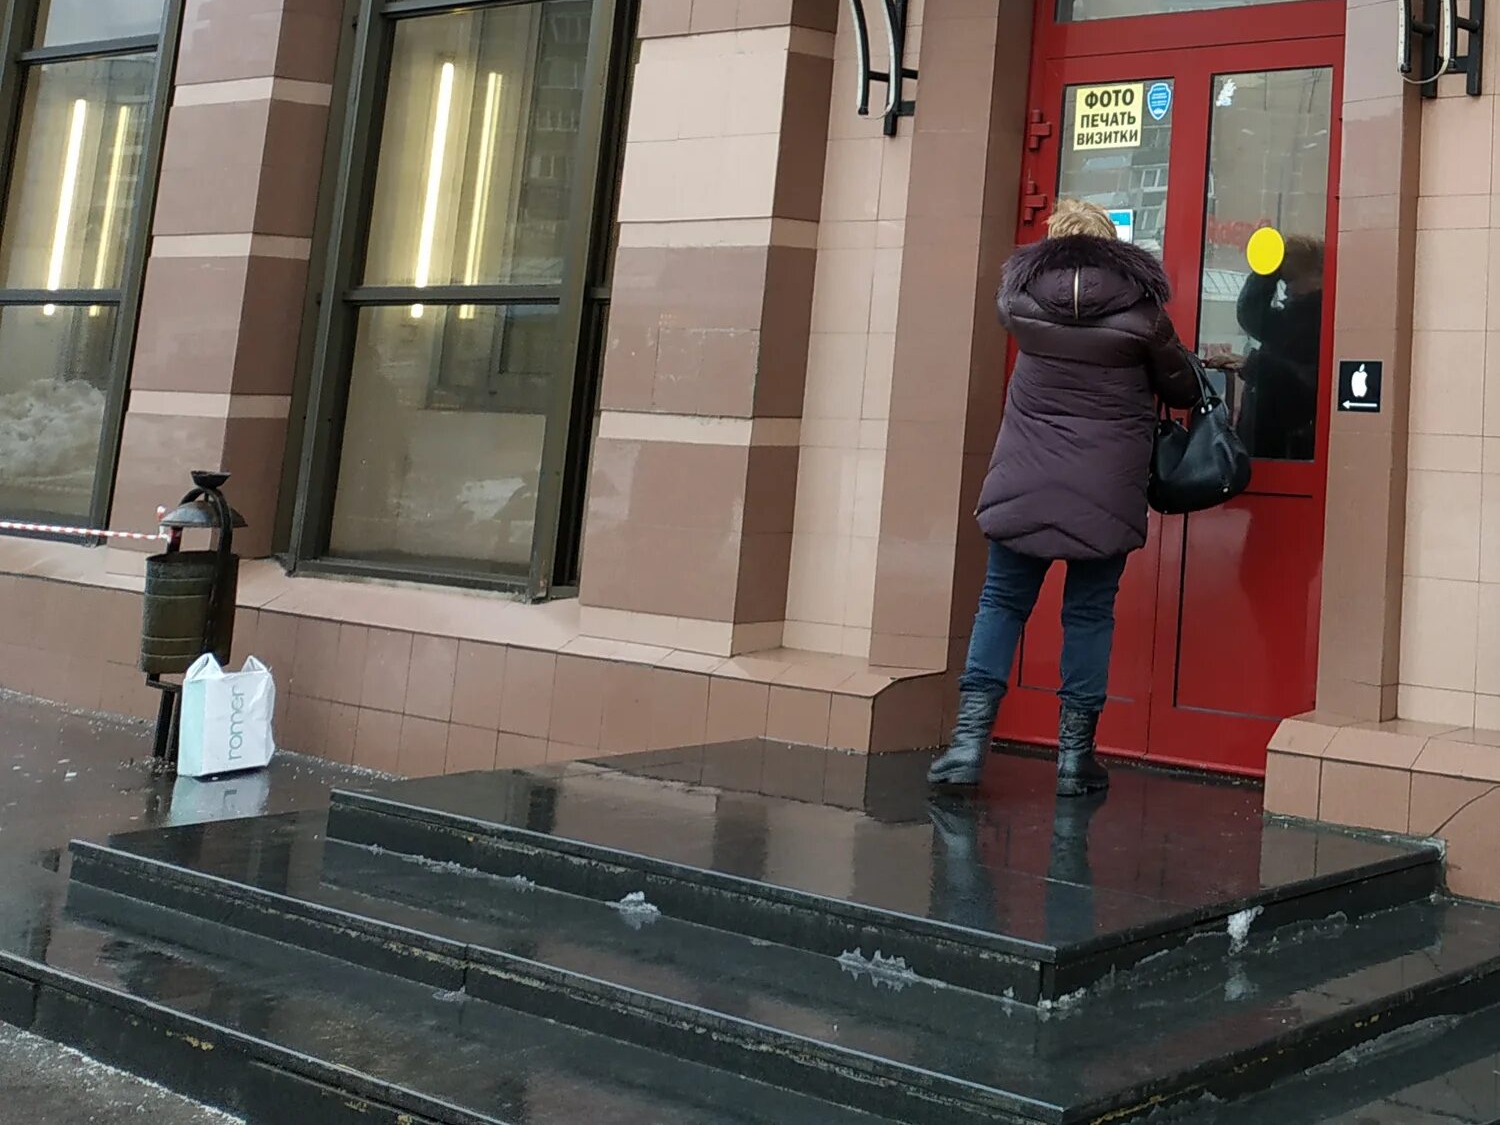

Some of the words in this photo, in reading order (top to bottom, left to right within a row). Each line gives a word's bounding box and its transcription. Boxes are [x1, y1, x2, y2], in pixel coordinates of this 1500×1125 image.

[1085, 88, 1134, 109] ФОТО
[1081, 111, 1136, 128] ПЕЧАТЬ
[1077, 129, 1138, 146] ВИЗИТКИ
[228, 685, 245, 761] romer
